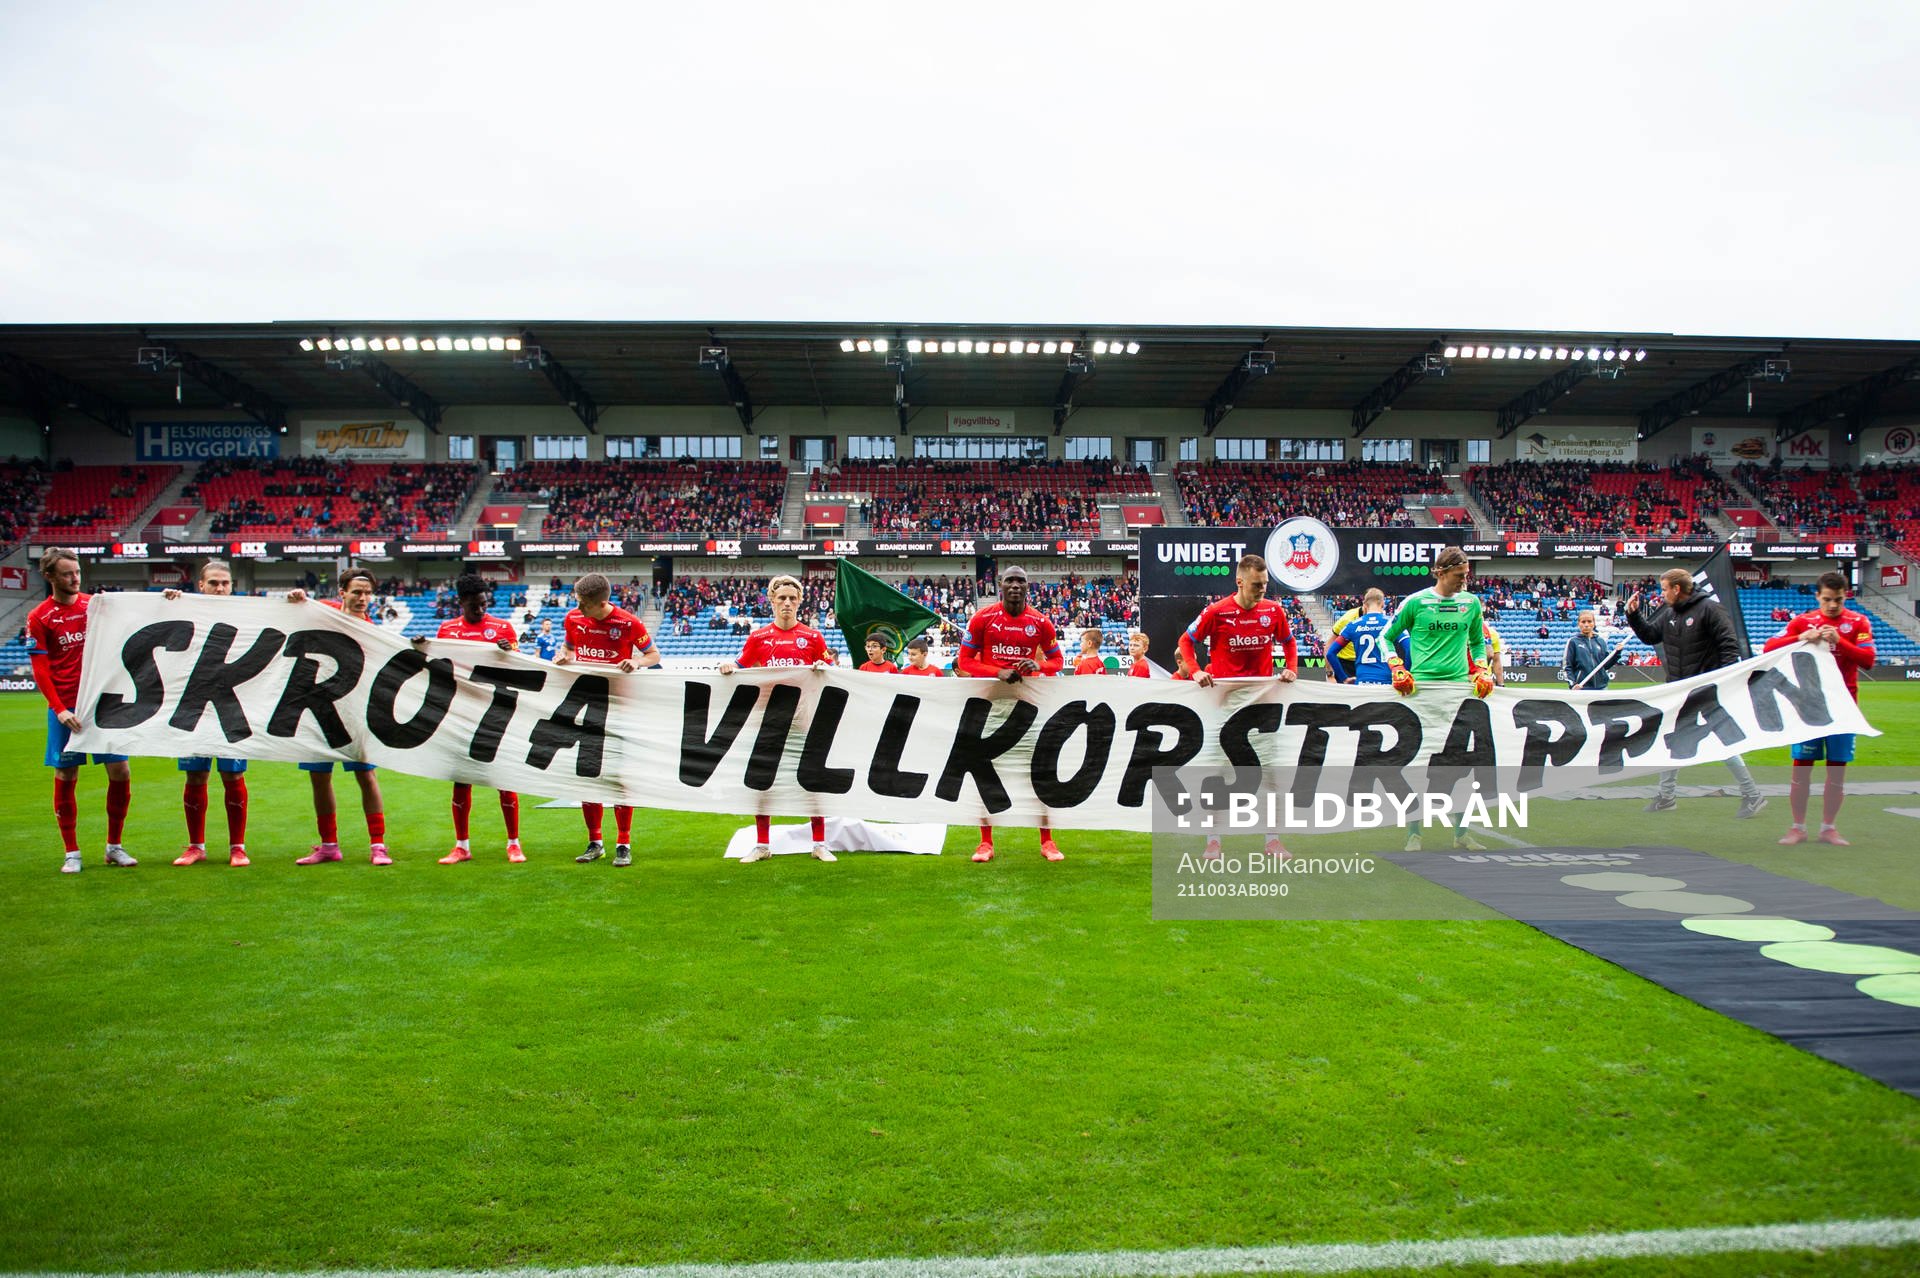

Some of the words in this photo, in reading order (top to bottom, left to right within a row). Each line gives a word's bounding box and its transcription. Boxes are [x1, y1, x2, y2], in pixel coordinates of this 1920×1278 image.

[953, 416, 1000, 427] #jagvillhbg
[315, 421, 409, 454] WALLIN
[172, 439, 272, 457] BYGGPLÅT
[1791, 434, 1823, 456] MAX
[1157, 543, 1246, 563] UNIBET
[1357, 543, 1446, 563] UNIBET
[728, 562, 765, 575] syster
[886, 560, 916, 572] bror
[1051, 560, 1112, 572] bultande
[1428, 620, 1458, 631] akea
[1229, 634, 1259, 646] akea
[577, 644, 605, 658] akea
[991, 643, 1021, 655] akea
[767, 655, 794, 667] akea
[95, 620, 609, 777] SKROTA
[679, 651, 1834, 817] VILLKORSTRAPPAN
